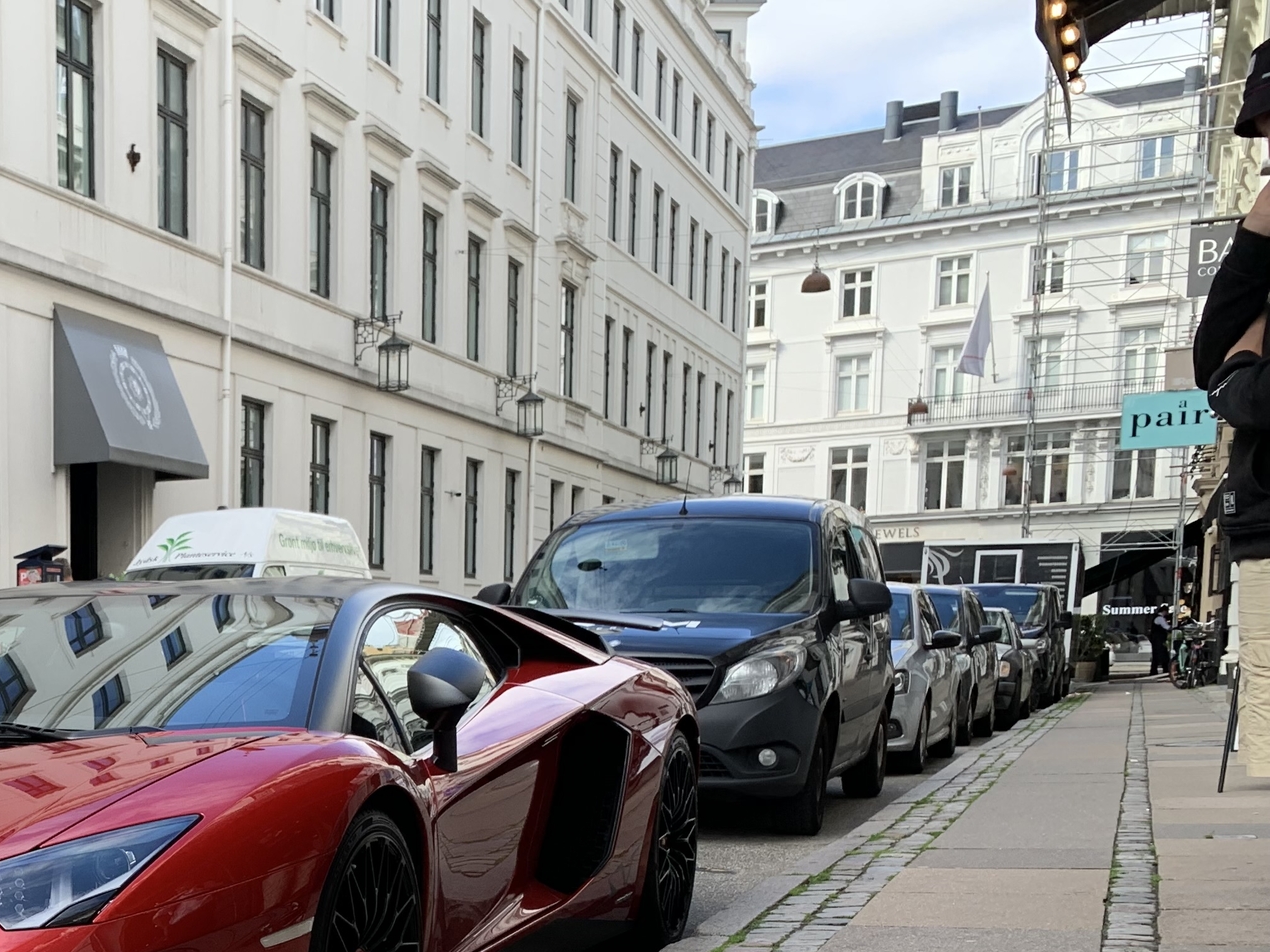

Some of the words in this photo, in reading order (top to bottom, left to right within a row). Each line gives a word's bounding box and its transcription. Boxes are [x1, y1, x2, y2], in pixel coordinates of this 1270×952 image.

[1179, 400, 1187, 408] a
[1129, 408, 1210, 438] pair
[1102, 604, 1157, 615] Summer
